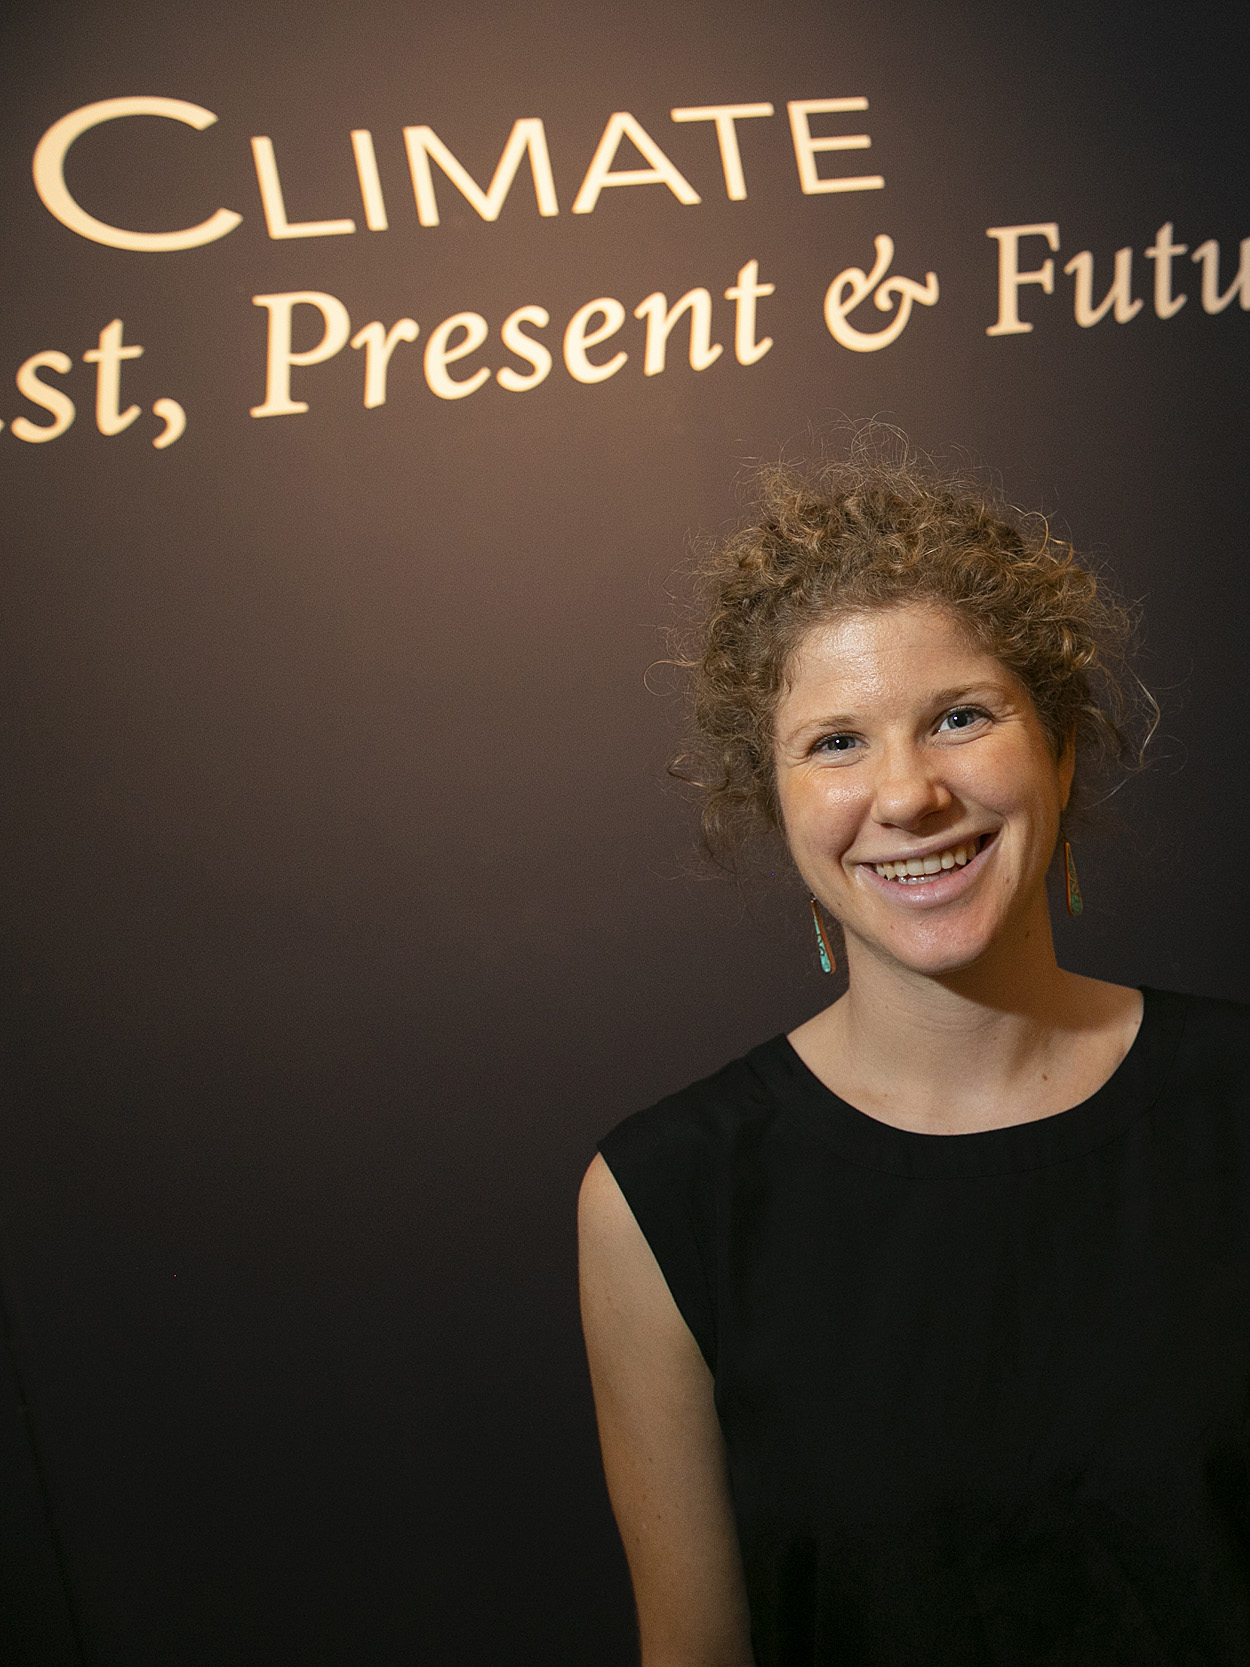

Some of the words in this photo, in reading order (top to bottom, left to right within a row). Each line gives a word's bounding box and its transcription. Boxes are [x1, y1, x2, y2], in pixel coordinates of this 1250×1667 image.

[33, 96, 885, 252] CLIMATE
[0, 319, 186, 449] st,
[251, 260, 775, 418] Present
[824, 235, 940, 353] &
